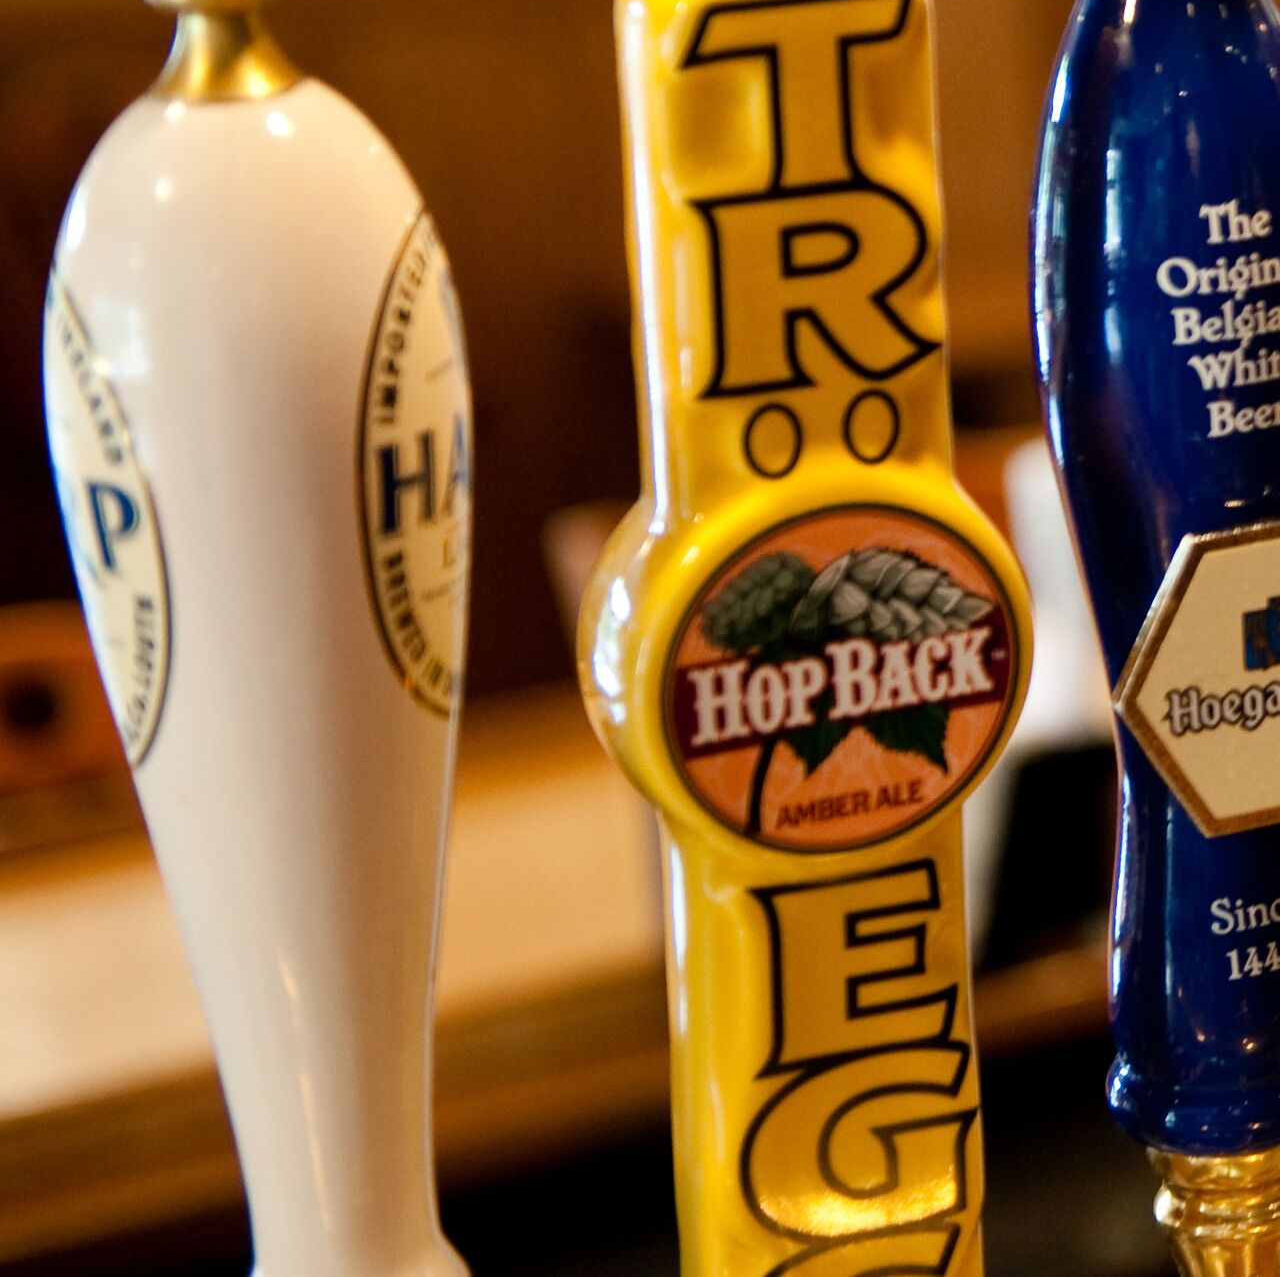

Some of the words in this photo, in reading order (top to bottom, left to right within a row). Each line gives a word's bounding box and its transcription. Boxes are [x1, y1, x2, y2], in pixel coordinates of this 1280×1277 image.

[1200, 198, 1272, 245] The
[775, 786, 873, 830] AMBER
[875, 779, 924, 809] ALE
